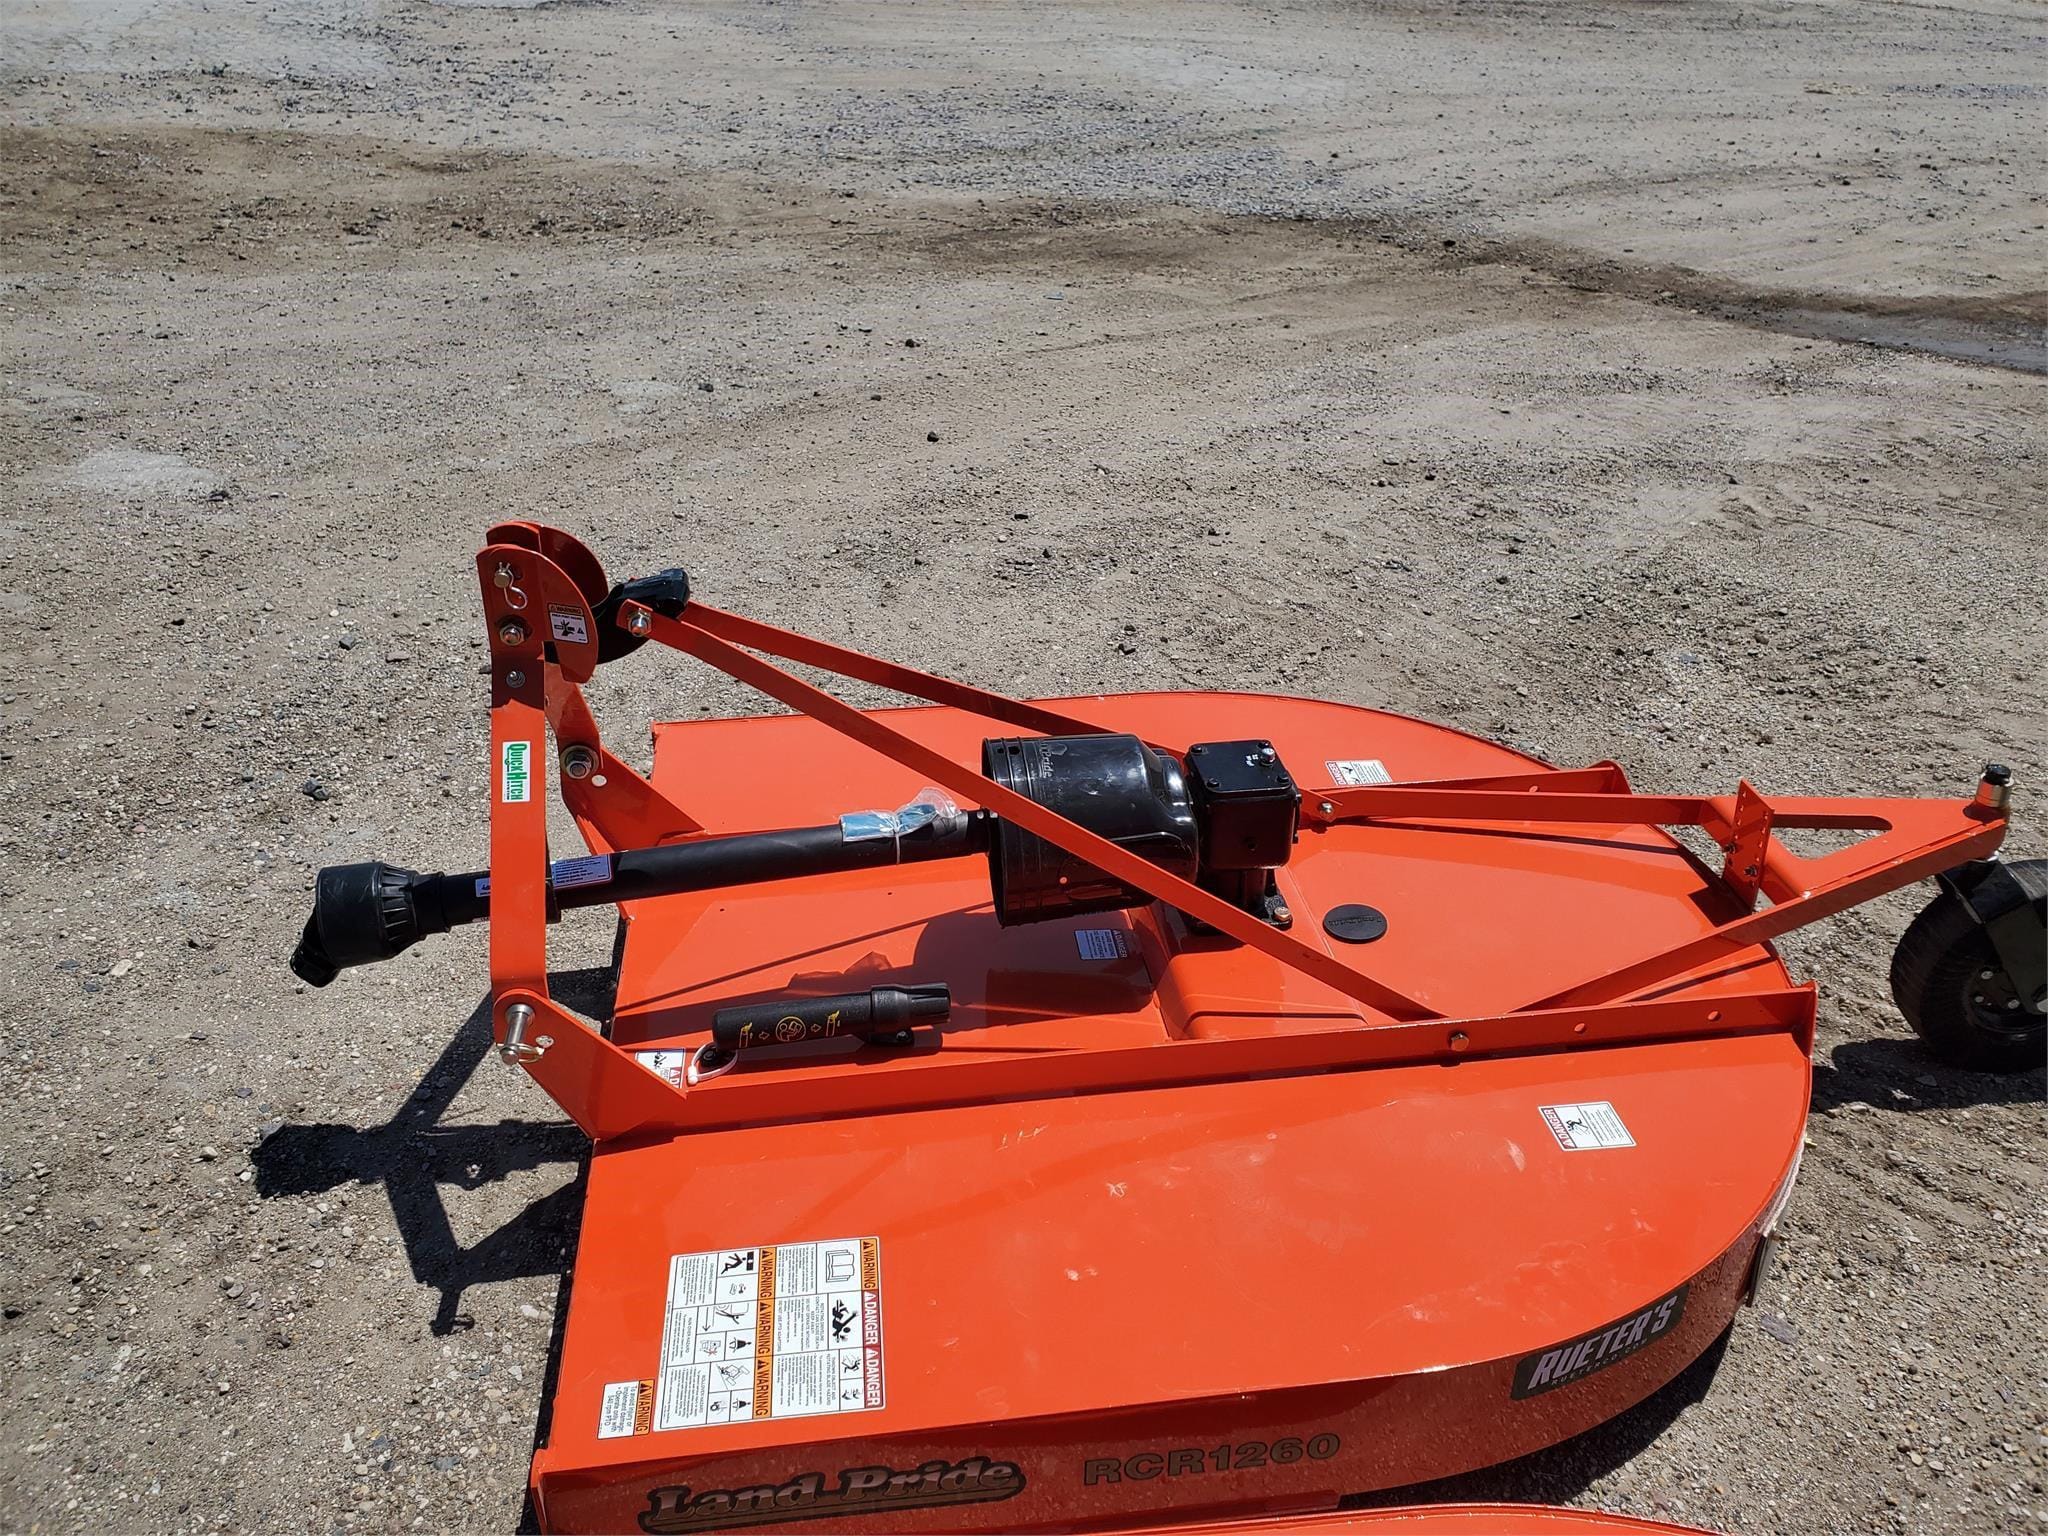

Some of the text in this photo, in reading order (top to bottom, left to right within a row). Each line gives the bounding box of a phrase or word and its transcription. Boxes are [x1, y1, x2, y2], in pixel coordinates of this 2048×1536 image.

[1543, 1109, 1568, 1139] DANGER
[759, 1259, 773, 1298] WARNING
[863, 1250, 876, 1289] WARNING
[757, 1311, 772, 1355] WARNING
[865, 1301, 878, 1345] DANGER
[1528, 1295, 1678, 1390] RUETER'S
[755, 1370, 769, 1417] WARNING
[866, 1359, 881, 1406] DANGER
[636, 1392, 651, 1432] WARNING
[1083, 1432, 1341, 1486] RCR1260
[652, 1459, 1015, 1522] Land Pride
